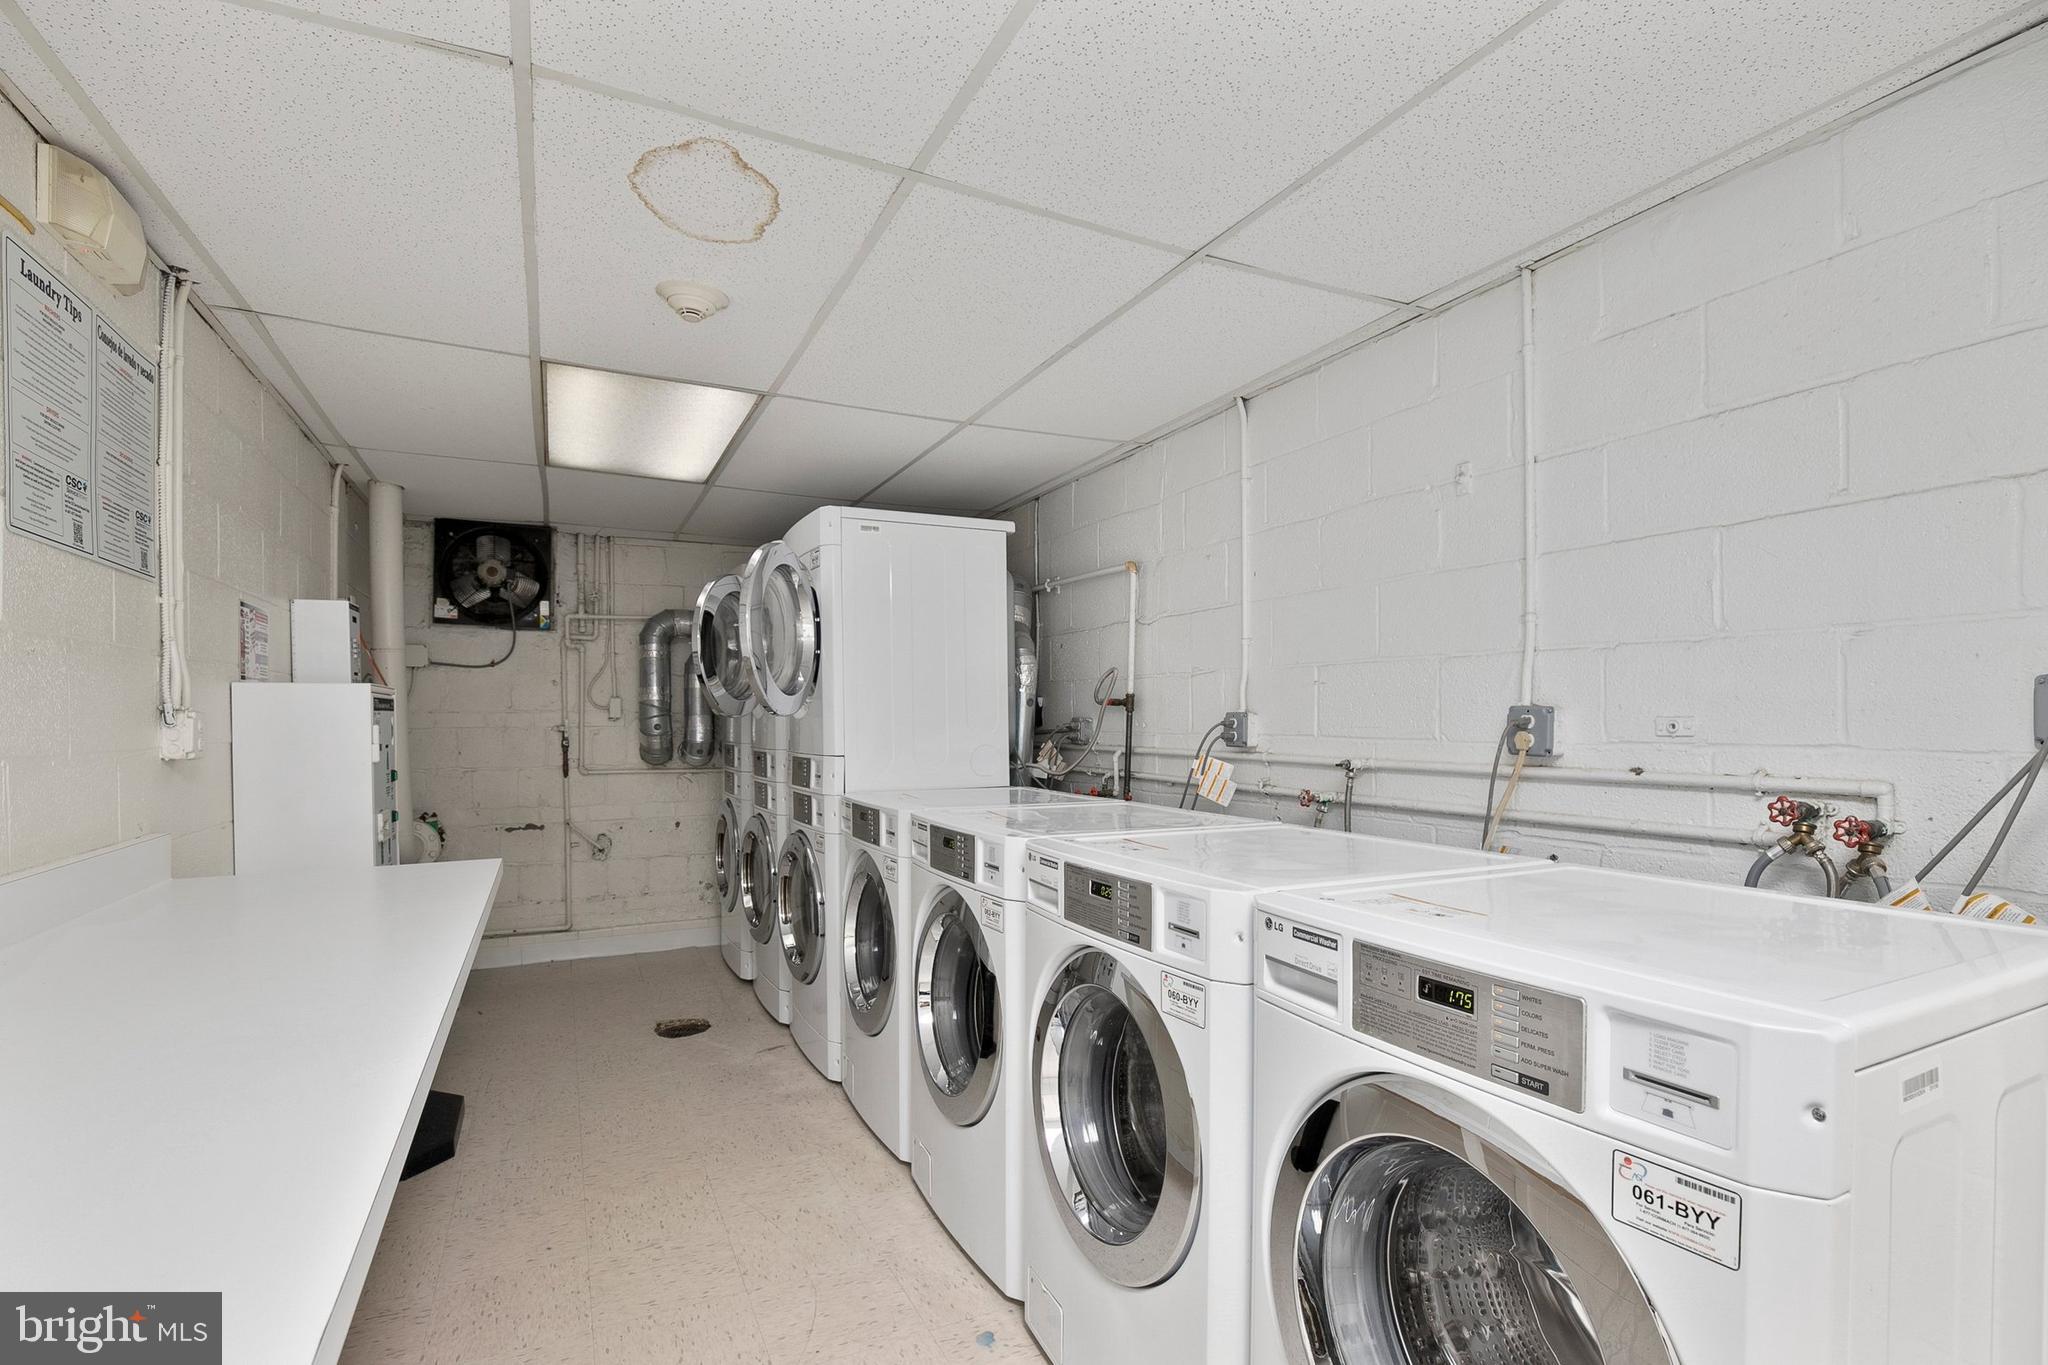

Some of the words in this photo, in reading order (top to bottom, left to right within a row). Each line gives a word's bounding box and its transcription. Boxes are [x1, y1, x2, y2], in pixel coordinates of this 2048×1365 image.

[20, 258, 62, 308] Laundry
[63, 294, 82, 322] Tips
[66, 475, 82, 491] CSC
[136, 510, 148, 523] CSC
[1294, 928, 1318, 944] Commercial
[1319, 936, 1337, 949] Washer
[1450, 990, 1472, 1008] 1.75
[1522, 994, 1542, 1005] WHITES
[1522, 1010, 1542, 1020] COLORS
[1521, 1026, 1548, 1039] DELICATES
[1538, 1046, 1555, 1056] PRESS
[1521, 1057, 1532, 1066] ADD
[1534, 1061, 1552, 1072] SUPER
[1553, 1066, 1568, 1077] WASH
[1521, 1077, 1544, 1090] START
[1632, 1185, 1720, 1230] 061-BYY
